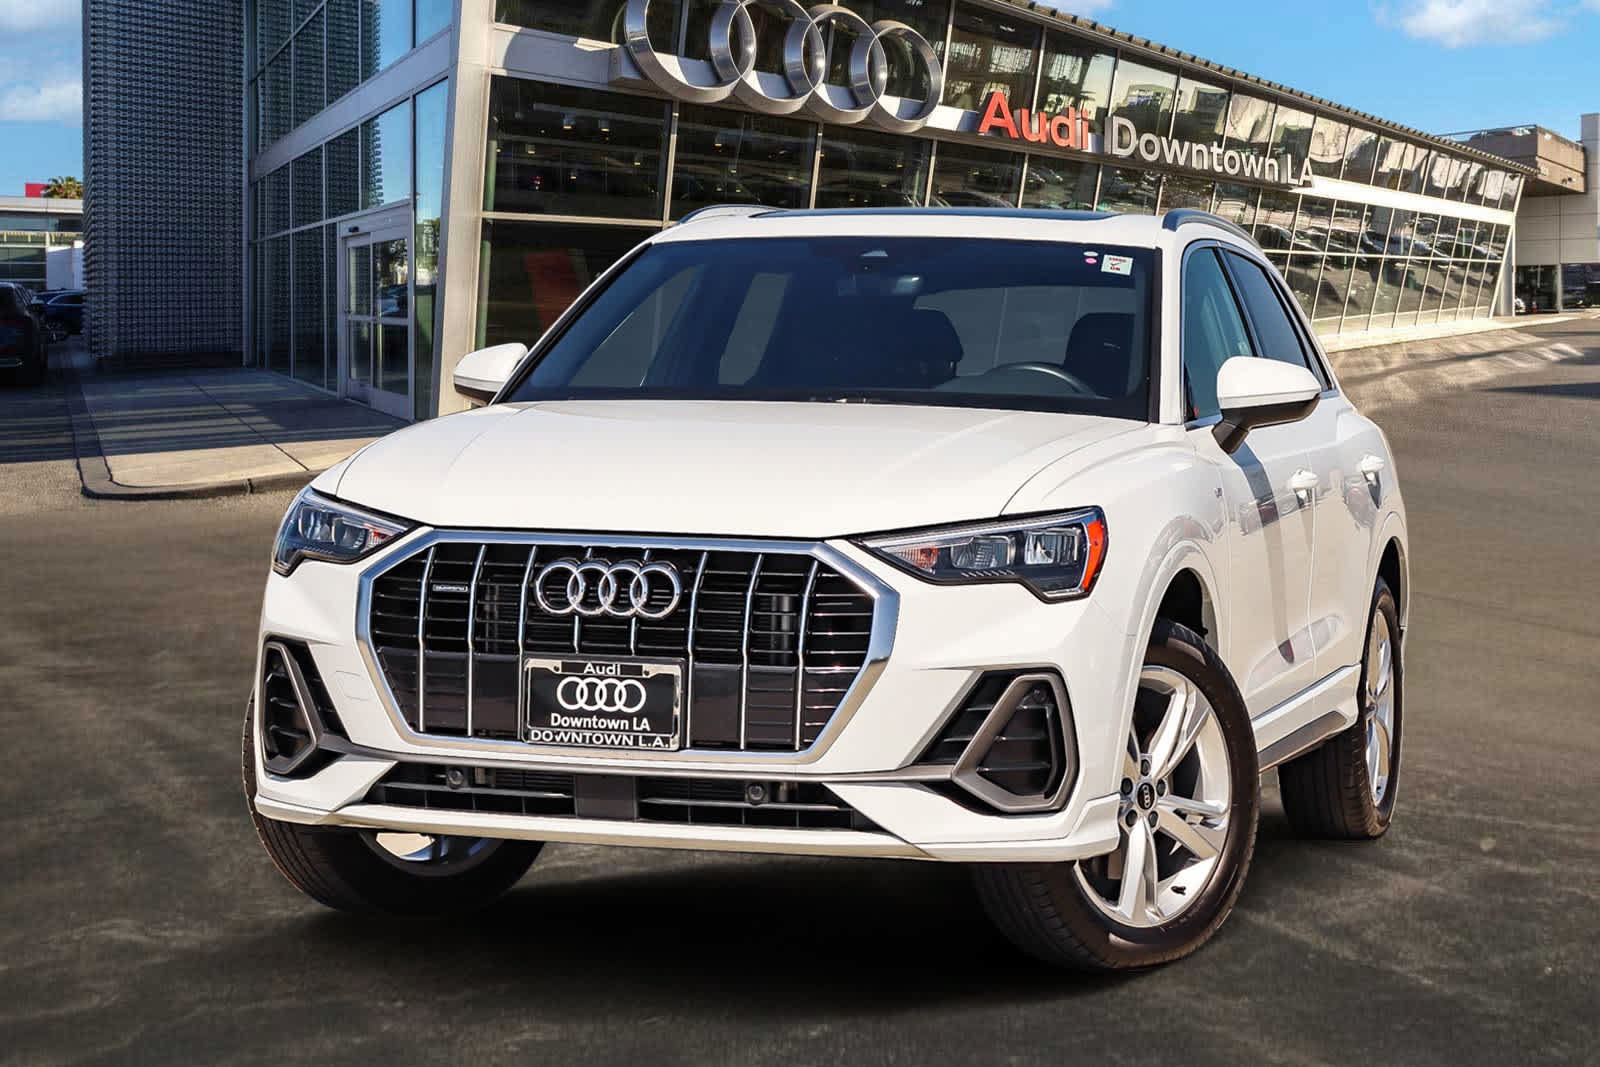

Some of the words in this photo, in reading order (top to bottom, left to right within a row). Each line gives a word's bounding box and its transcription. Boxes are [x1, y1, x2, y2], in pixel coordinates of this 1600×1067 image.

[978, 91, 1089, 151] Audi
[1105, 116, 1281, 184] Downtown
[1286, 153, 1316, 189] LA
[584, 662, 621, 675] Audi
[551, 713, 629, 730] Downtown
[633, 717, 650, 731] LA
[531, 730, 634, 746] DOWNTOWN
[638, 736, 669, 748] L.A.
